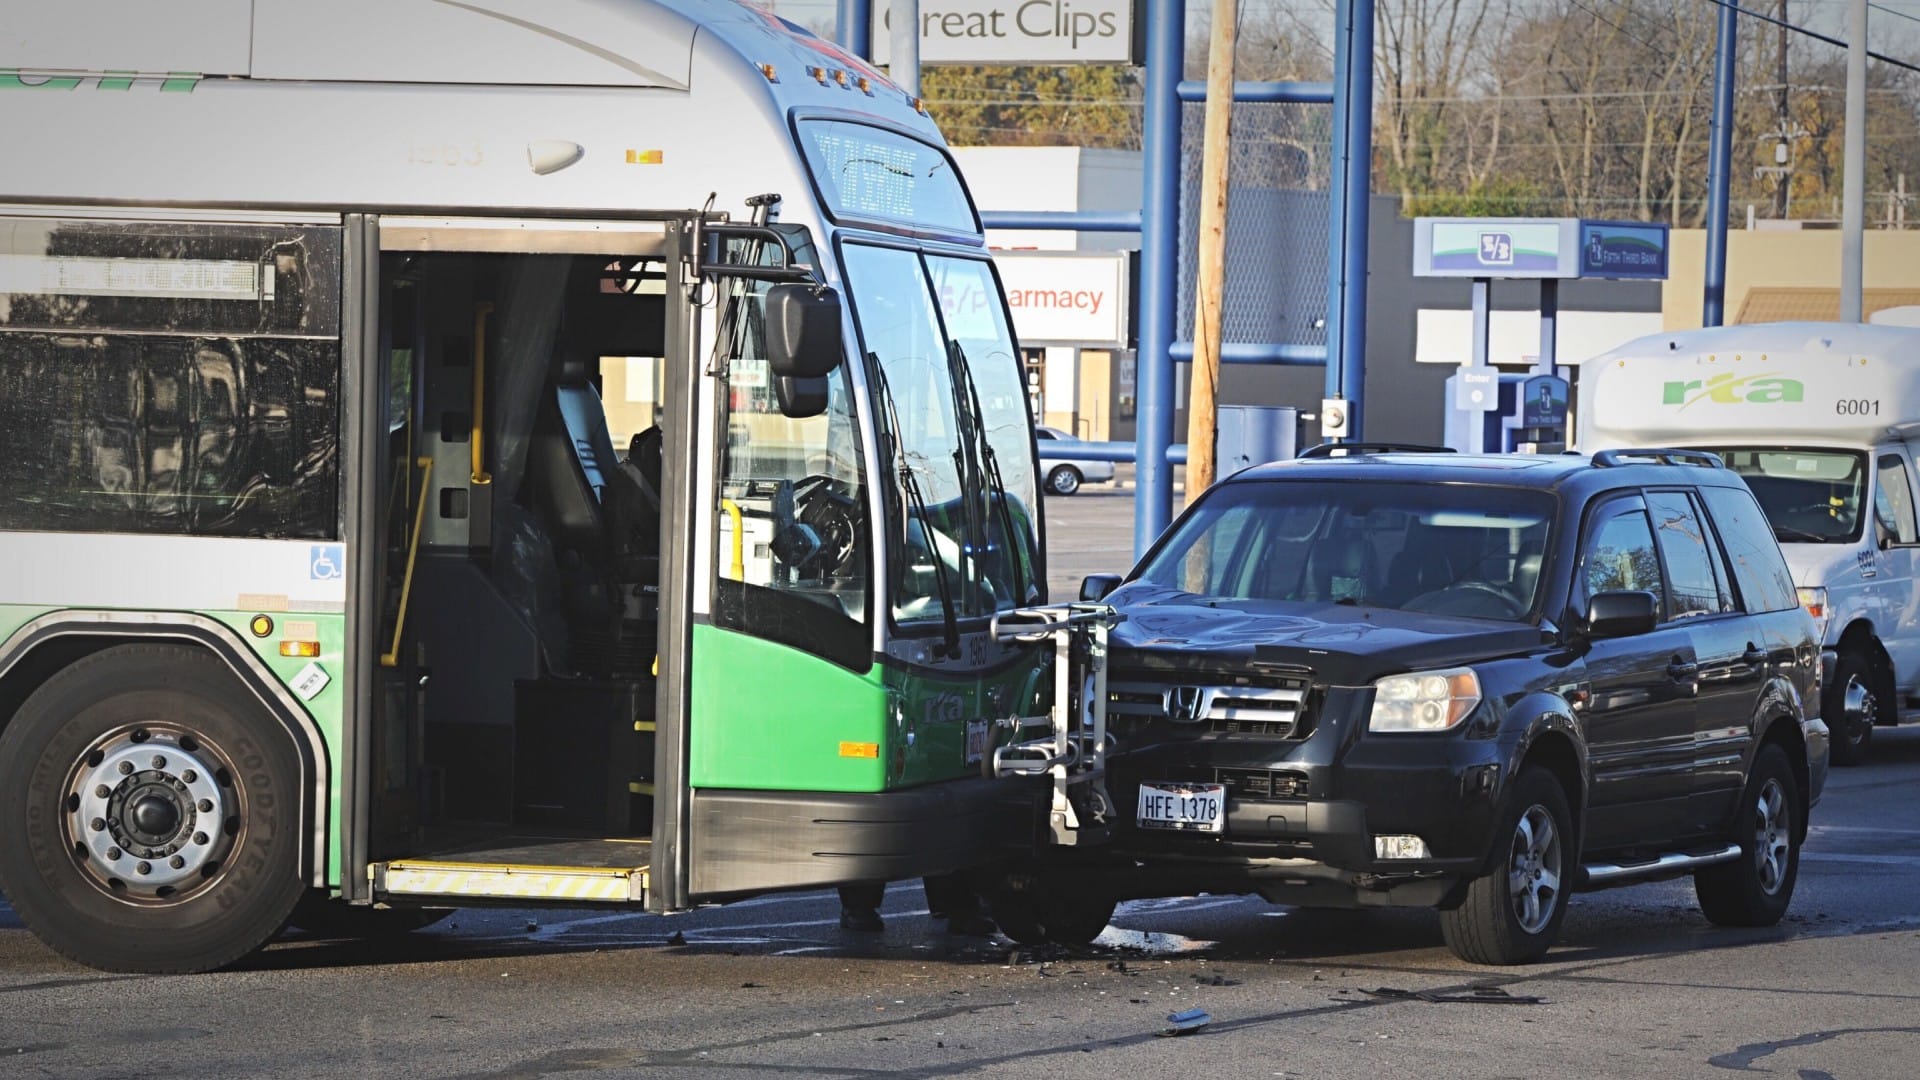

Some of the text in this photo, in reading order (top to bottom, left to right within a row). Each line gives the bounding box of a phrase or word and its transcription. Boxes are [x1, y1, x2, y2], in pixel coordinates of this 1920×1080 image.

[884, 0, 1117, 49] reat Clips
[1662, 372, 1805, 408] rta
[1836, 399, 1880, 416] 6001
[1145, 795, 1217, 820] HFE 1378
